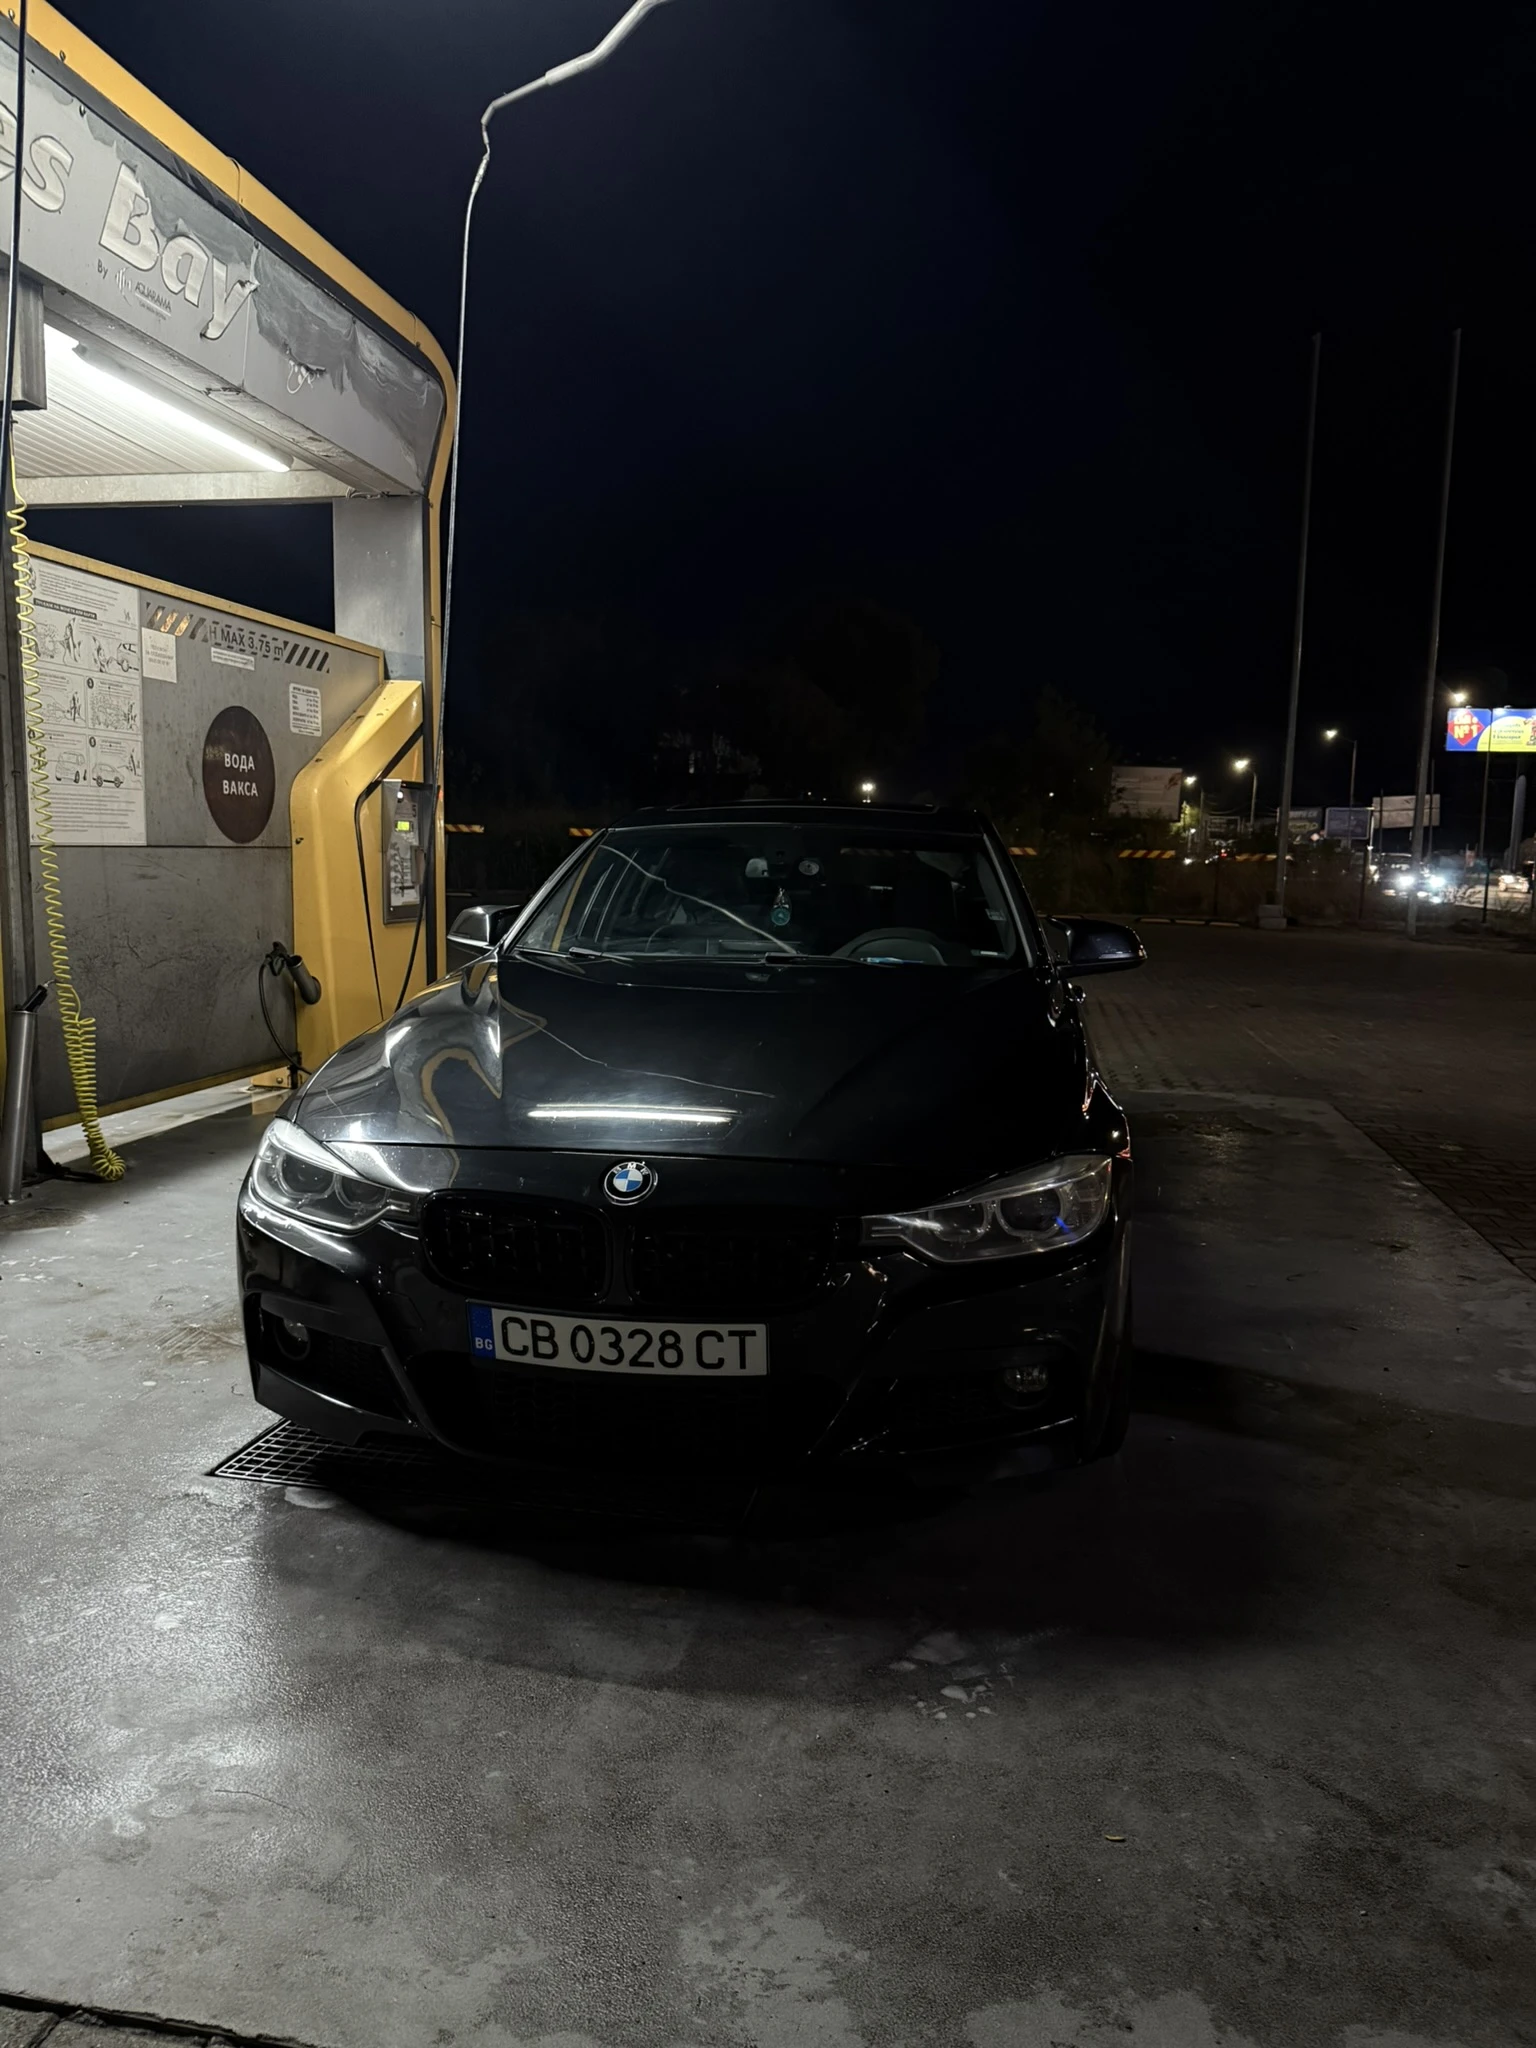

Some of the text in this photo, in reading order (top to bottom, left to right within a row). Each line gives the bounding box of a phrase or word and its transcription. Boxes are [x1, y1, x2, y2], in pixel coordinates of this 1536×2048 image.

[98, 161, 258, 340] Bay
[98, 258, 108, 279] By
[209, 625, 284, 657] H MAX 3.75 m
[224, 753, 255, 772] ВОДА
[223, 779, 258, 797] ВАКСА
[475, 1337, 493, 1351] BG
[501, 1316, 757, 1370] CB 0328 CT
